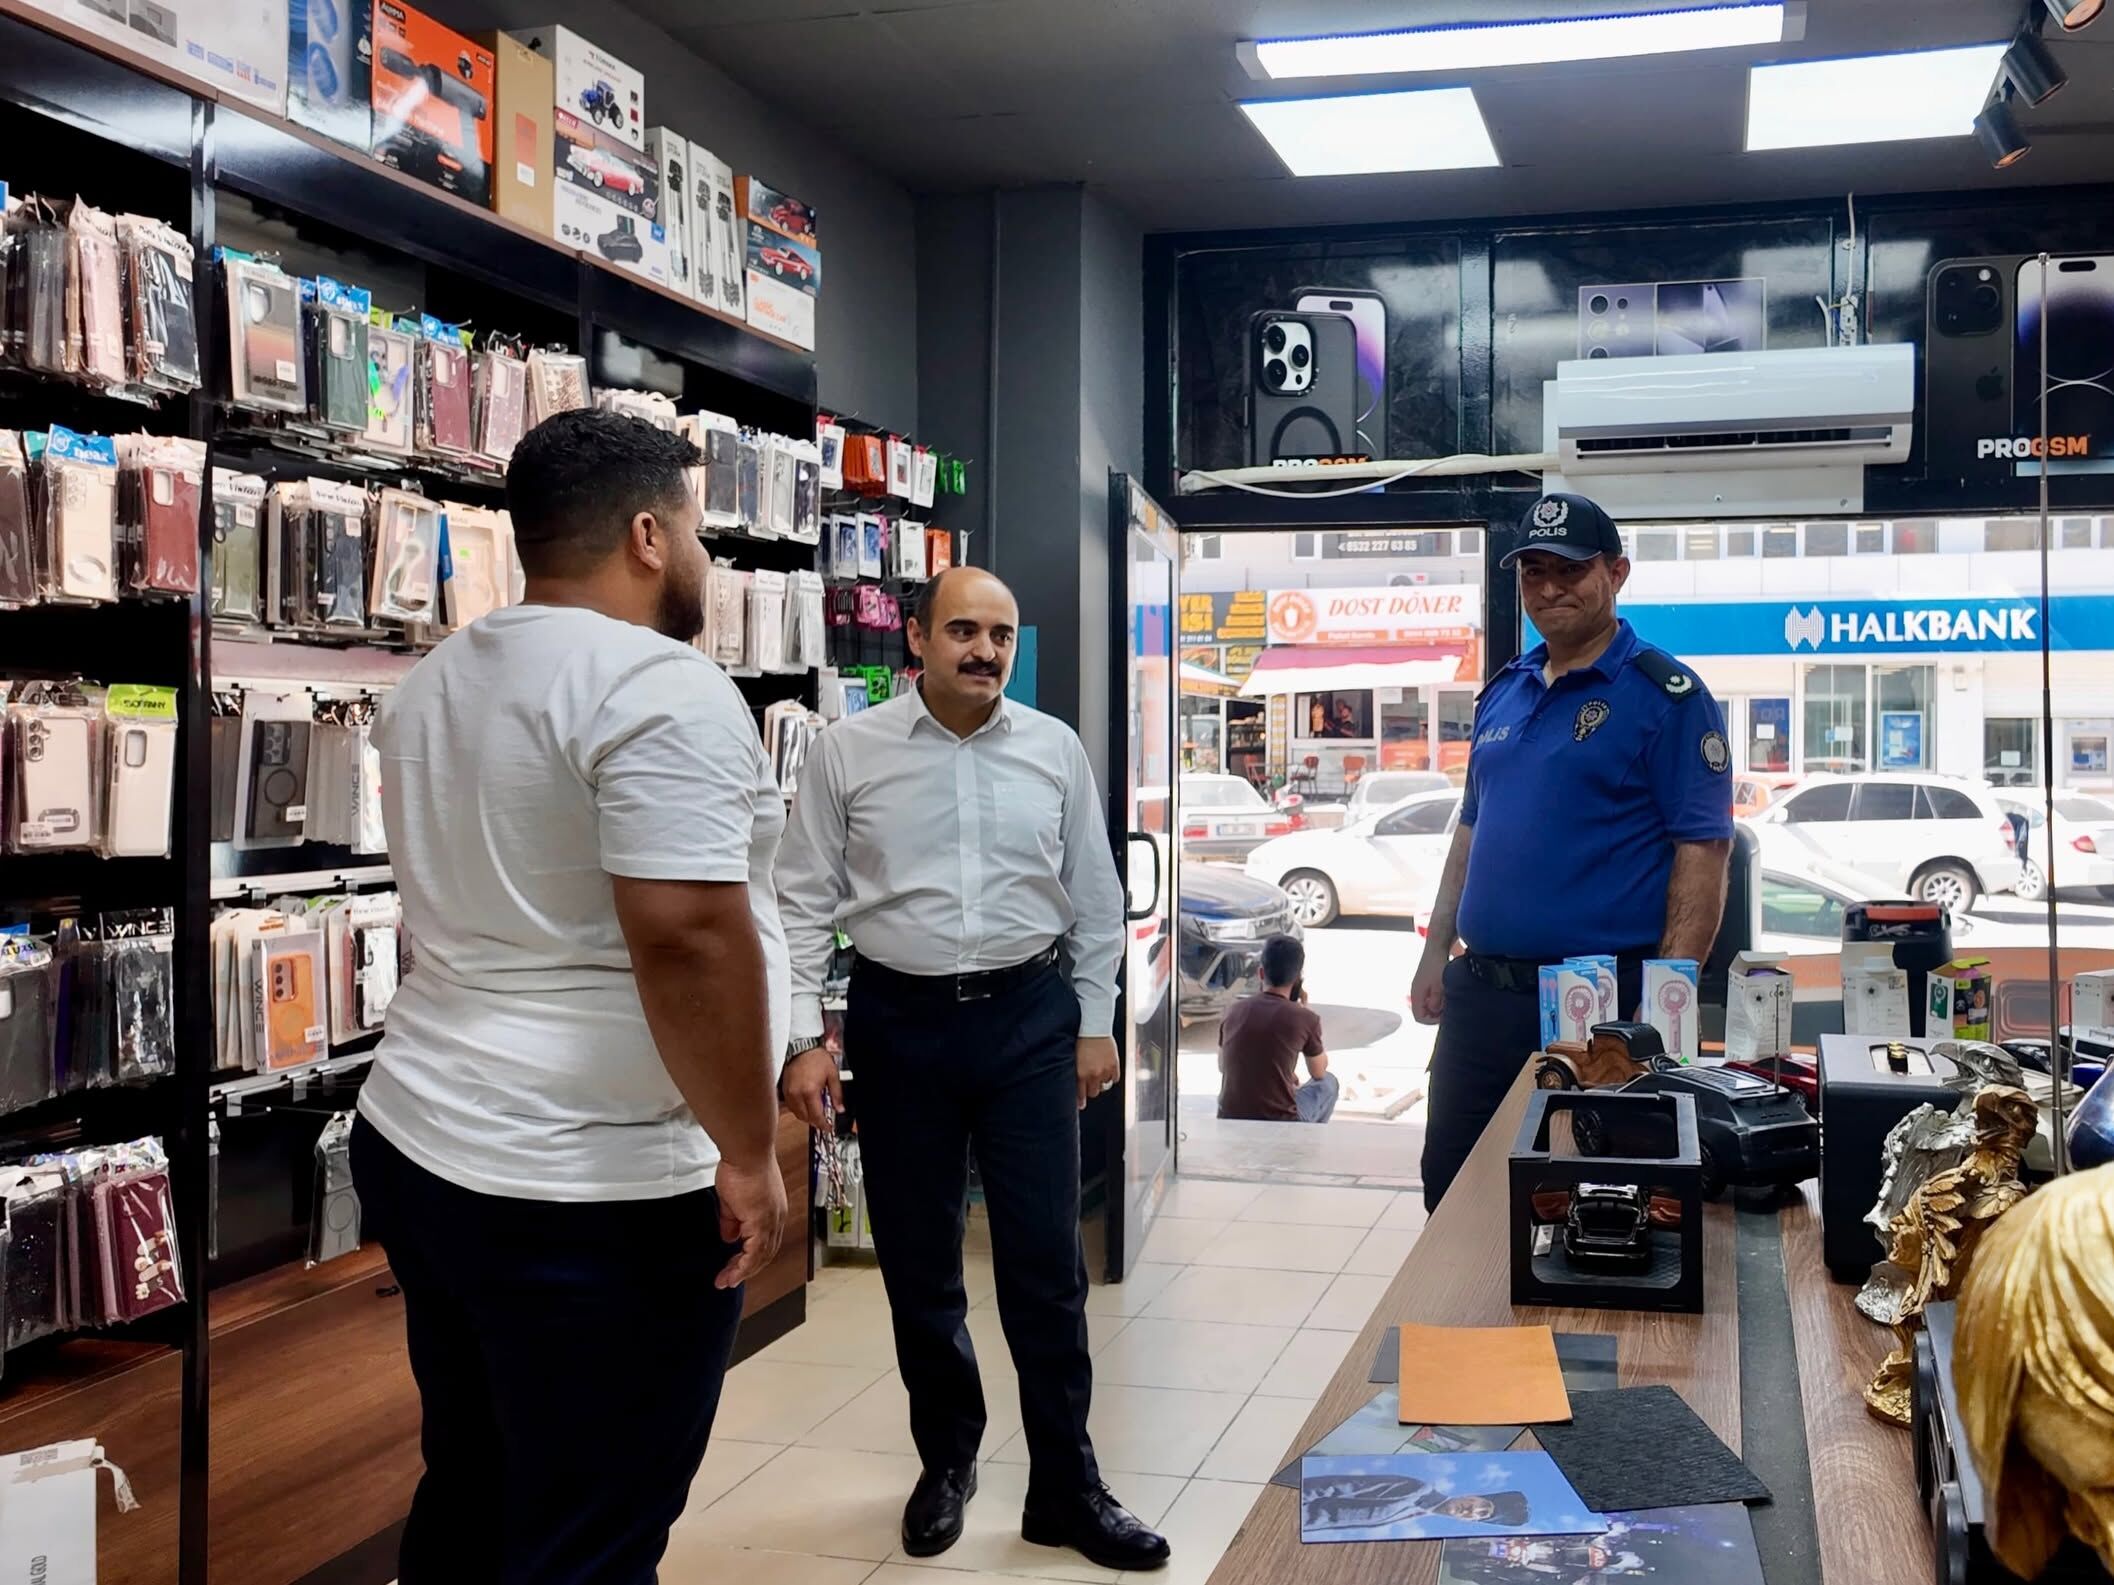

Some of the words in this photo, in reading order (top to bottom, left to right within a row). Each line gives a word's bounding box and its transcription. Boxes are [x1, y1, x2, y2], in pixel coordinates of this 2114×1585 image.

[1976, 436, 2088, 459] PROGSM
[1328, 598, 1385, 617] DOST
[1388, 591, 1463, 616] DÖNER
[1830, 607, 2038, 643] HALKBANK
